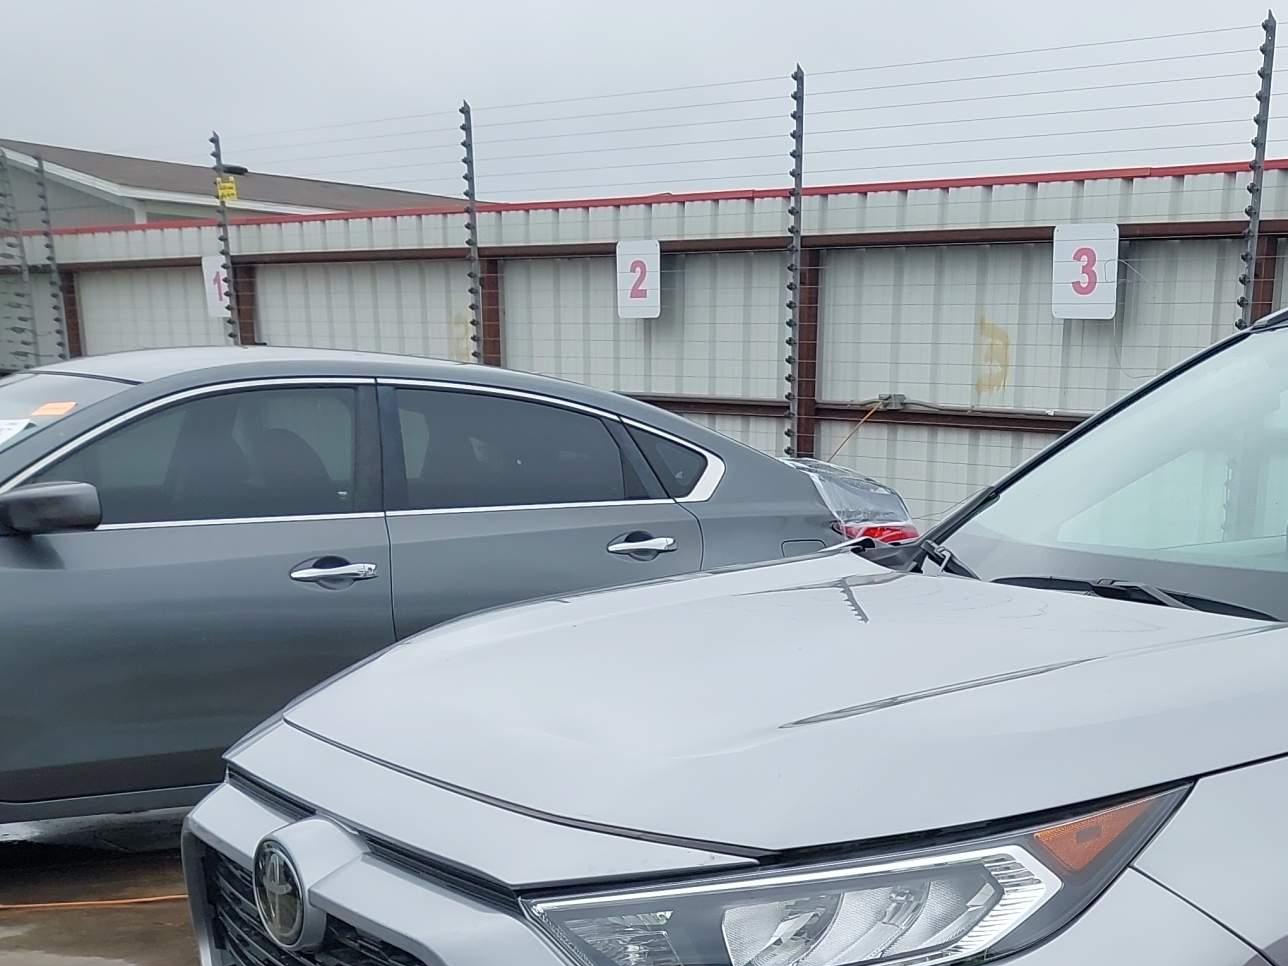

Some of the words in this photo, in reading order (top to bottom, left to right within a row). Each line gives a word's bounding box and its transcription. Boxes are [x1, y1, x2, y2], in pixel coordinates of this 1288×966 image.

[213, 271, 224, 301] 1
[629, 260, 648, 298] 2
[1072, 247, 1098, 295] 3
